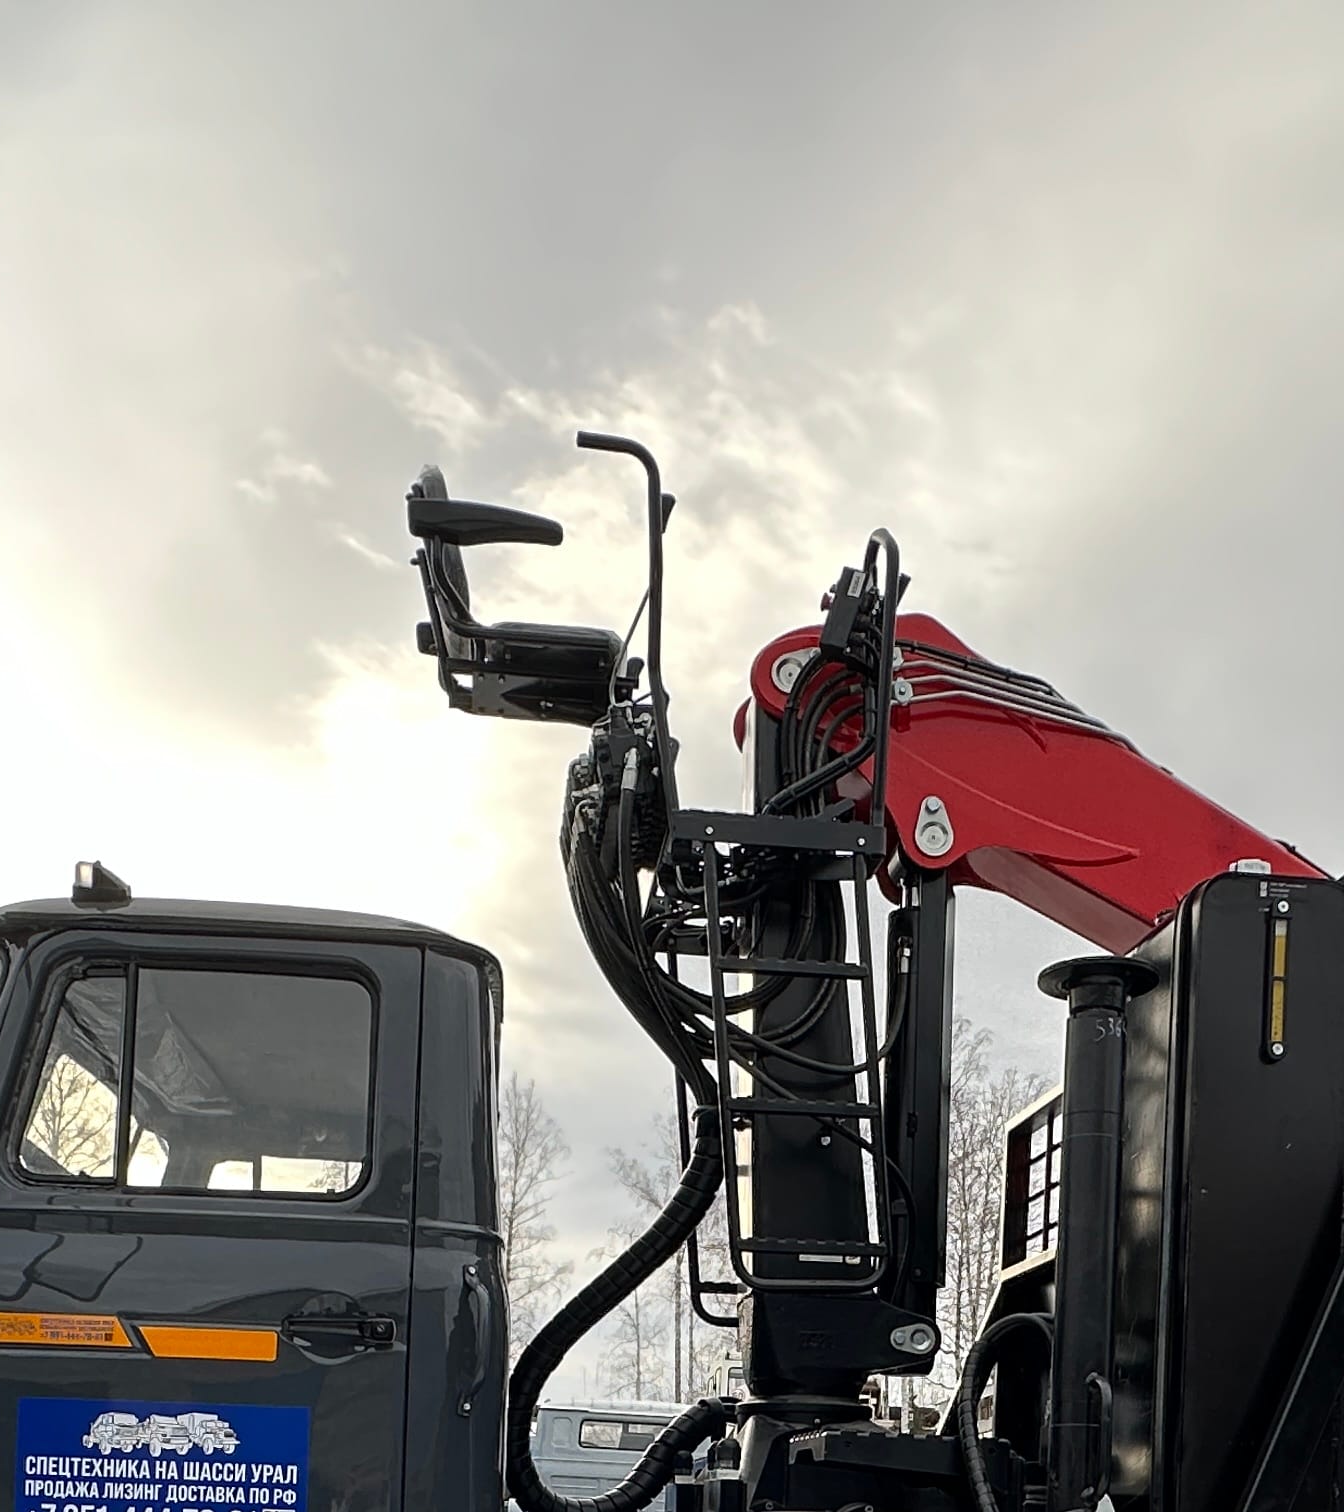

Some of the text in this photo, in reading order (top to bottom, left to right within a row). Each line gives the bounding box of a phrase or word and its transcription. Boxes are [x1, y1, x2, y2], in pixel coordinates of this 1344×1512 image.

[25, 1455, 298, 1485] СПЕЦТЕХНИКА НА ШАССИ УРАЛ
[25, 1480, 297, 1505] ПРОДАЖА ЛИЗИНГ ДОСТАВКА ПО РФ
